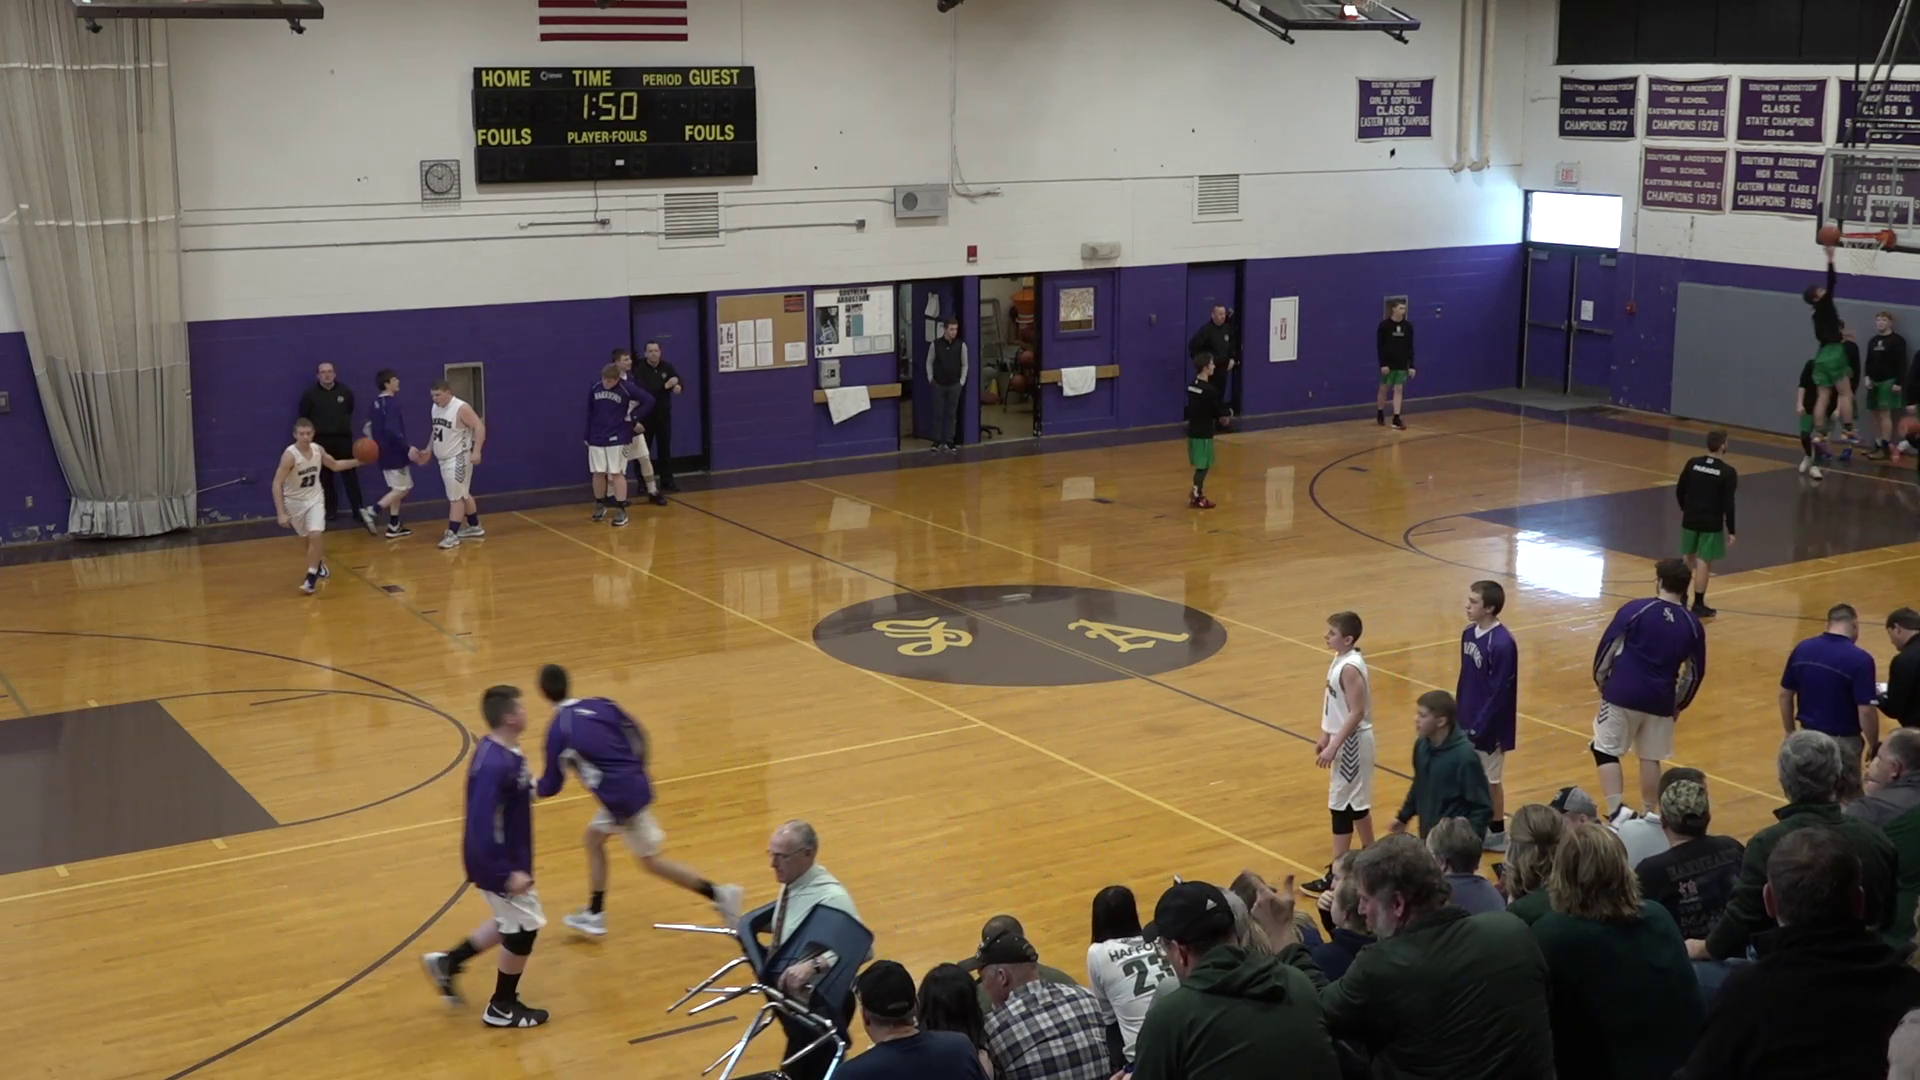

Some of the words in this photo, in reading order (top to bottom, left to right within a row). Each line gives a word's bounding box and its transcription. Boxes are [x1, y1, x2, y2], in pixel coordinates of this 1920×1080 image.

[482, 70, 531, 87] HOME
[572, 70, 612, 87] TIME
[643, 74, 682, 86] PERIOD
[689, 69, 739, 85] GUEST
[583, 92, 638, 120] 1:50
[1369, 96, 1388, 105] GIRLS
[1390, 96, 1422, 104] SOFTBALL
[1376, 105, 1406, 116] CLASS
[1762, 104, 1791, 113] CLASS
[1793, 104, 1800, 113] C
[1905, 106, 1913, 115] D
[1360, 116, 1384, 127] EASTERN
[1564, 120, 1607, 131] CHAMPIONS
[1652, 119, 1696, 131] CHAMPIONS
[1745, 116, 1770, 126] STATE
[1771, 117, 1815, 127] CHAMPIONS
[685, 124, 735, 141] FOULS
[1383, 127, 1406, 135] 1997
[477, 128, 532, 146] FOULS
[1644, 178, 1673, 186] EASTERN
[1736, 182, 1765, 191] EASTERN
[1767, 183, 1786, 192] MAINE
[1789, 184, 1810, 193] CLASS
[1855, 184, 1891, 194] CLASS
[1896, 186, 1903, 195] D
[1646, 190, 1694, 203] CHAMPIONS
[1737, 195, 1786, 207] CHAMPIONS
[1791, 197, 1813, 209] 1986
